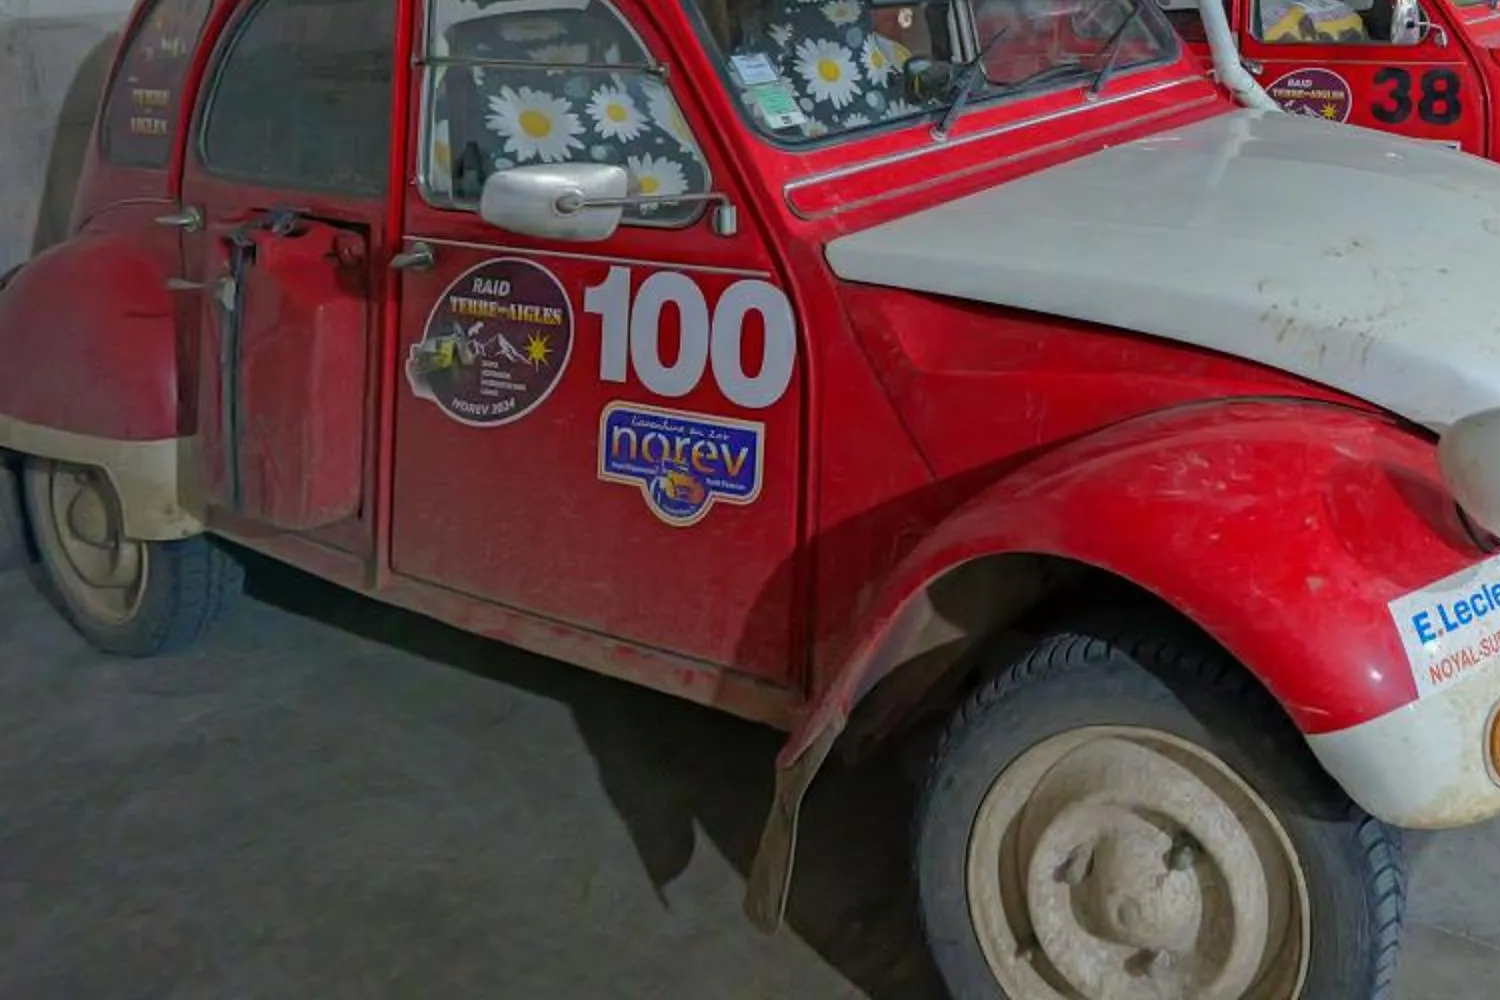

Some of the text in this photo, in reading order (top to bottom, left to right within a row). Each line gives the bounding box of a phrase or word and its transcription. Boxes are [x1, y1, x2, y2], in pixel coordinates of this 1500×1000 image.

[1372, 68, 1461, 124] 38
[471, 277, 511, 297] RAID
[584, 266, 797, 408] 100
[452, 398, 489, 415] NOREV
[612, 425, 749, 477] norev
